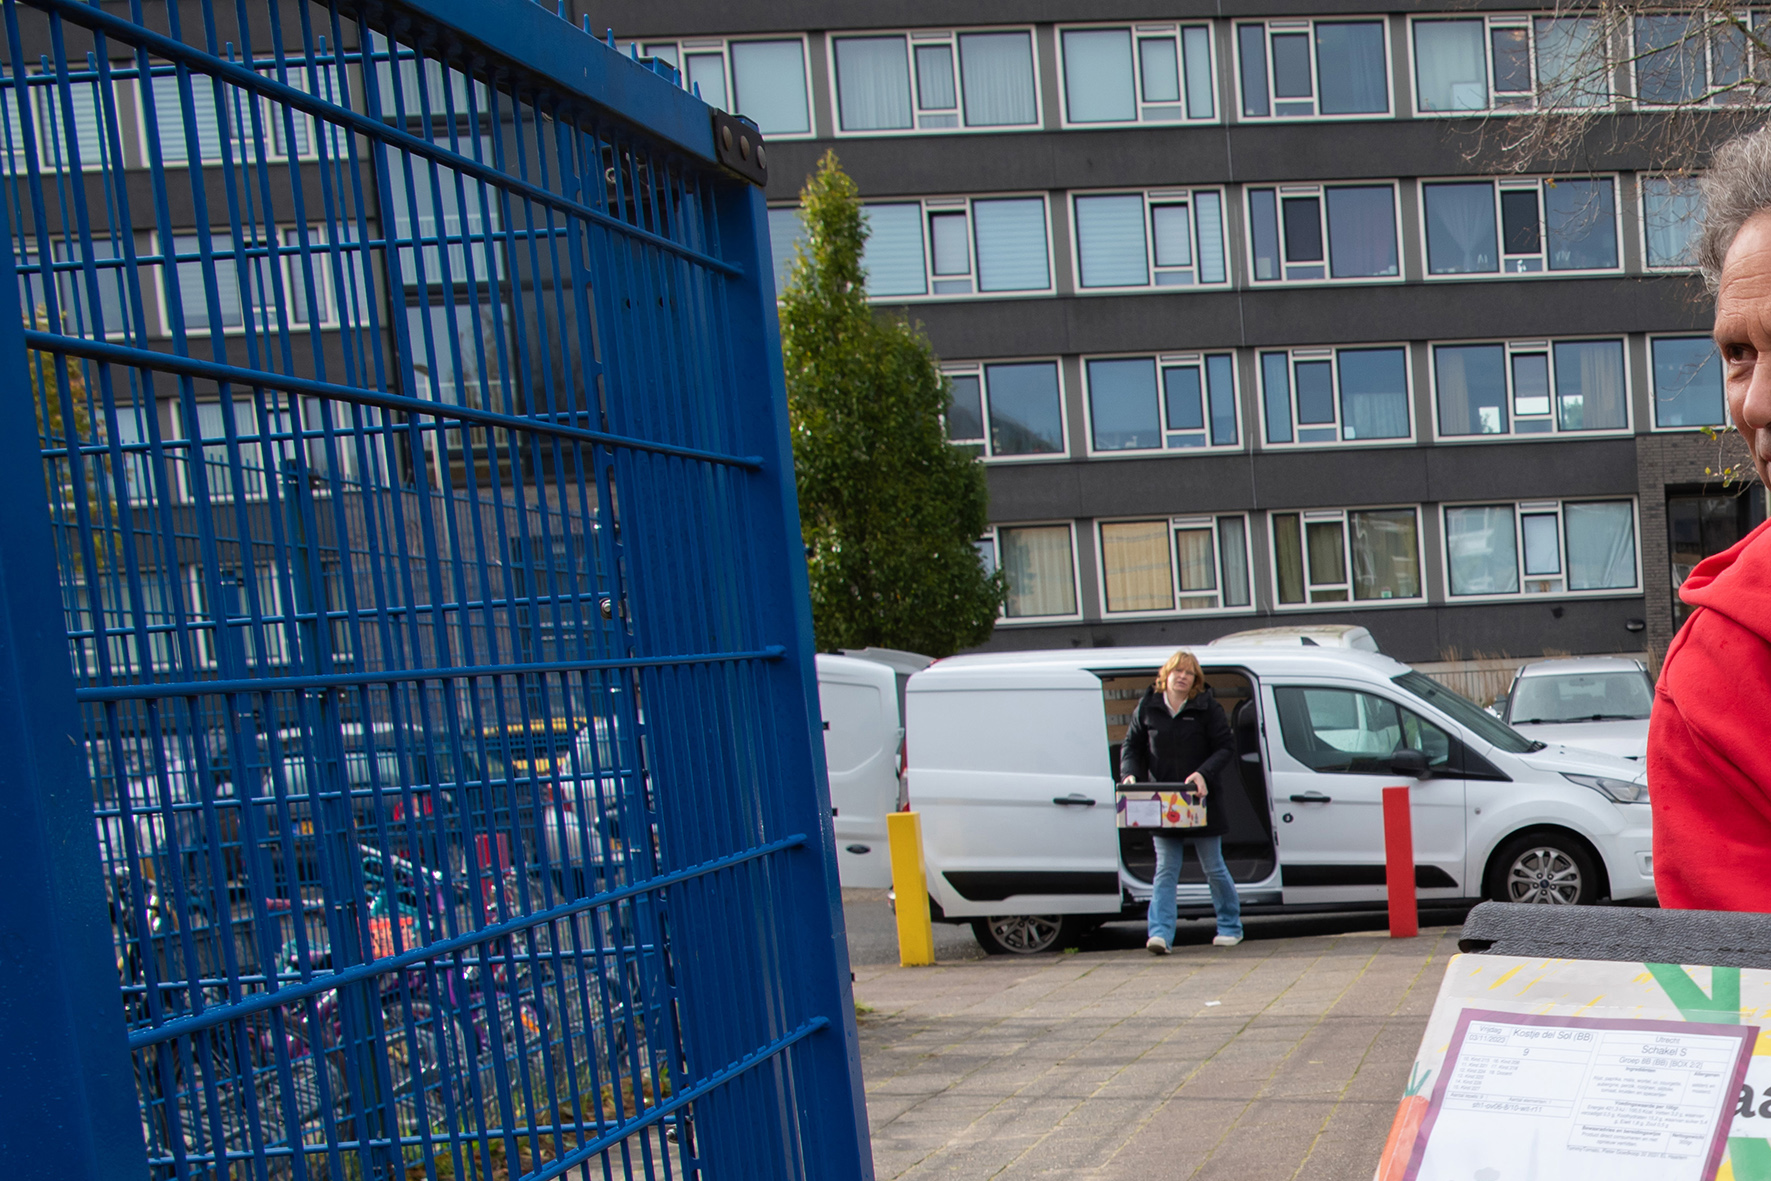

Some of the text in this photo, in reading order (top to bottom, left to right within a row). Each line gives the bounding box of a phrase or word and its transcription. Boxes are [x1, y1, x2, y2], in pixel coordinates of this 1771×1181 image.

[1512, 1028, 1594, 1042] Kostje del Sol (BB)
[1522, 1048, 1529, 1056] 9
[1641, 1045, 1687, 1056] Schakel S
